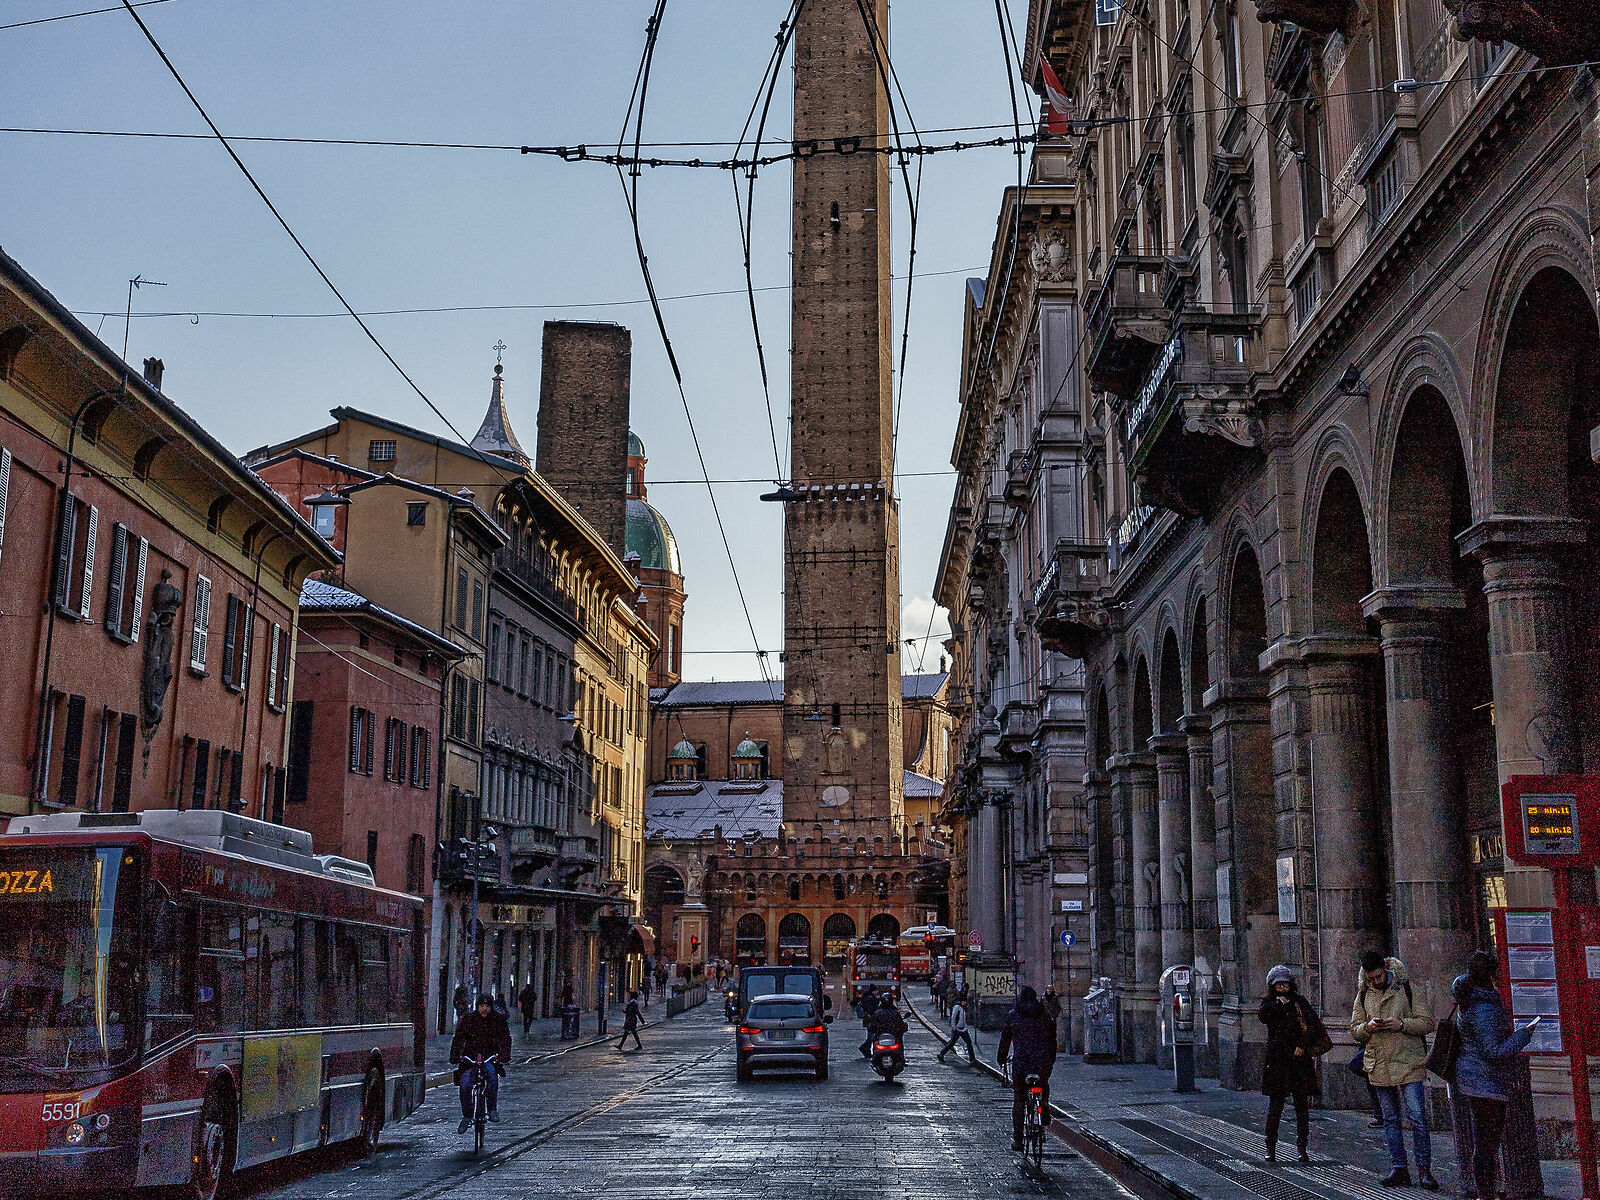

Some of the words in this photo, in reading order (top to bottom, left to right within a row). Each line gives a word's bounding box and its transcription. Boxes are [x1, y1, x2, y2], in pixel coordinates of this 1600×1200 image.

[1527, 806, 1538, 814] 25
[1529, 826, 1540, 834] 20
[41, 1102, 80, 1121] 5591
